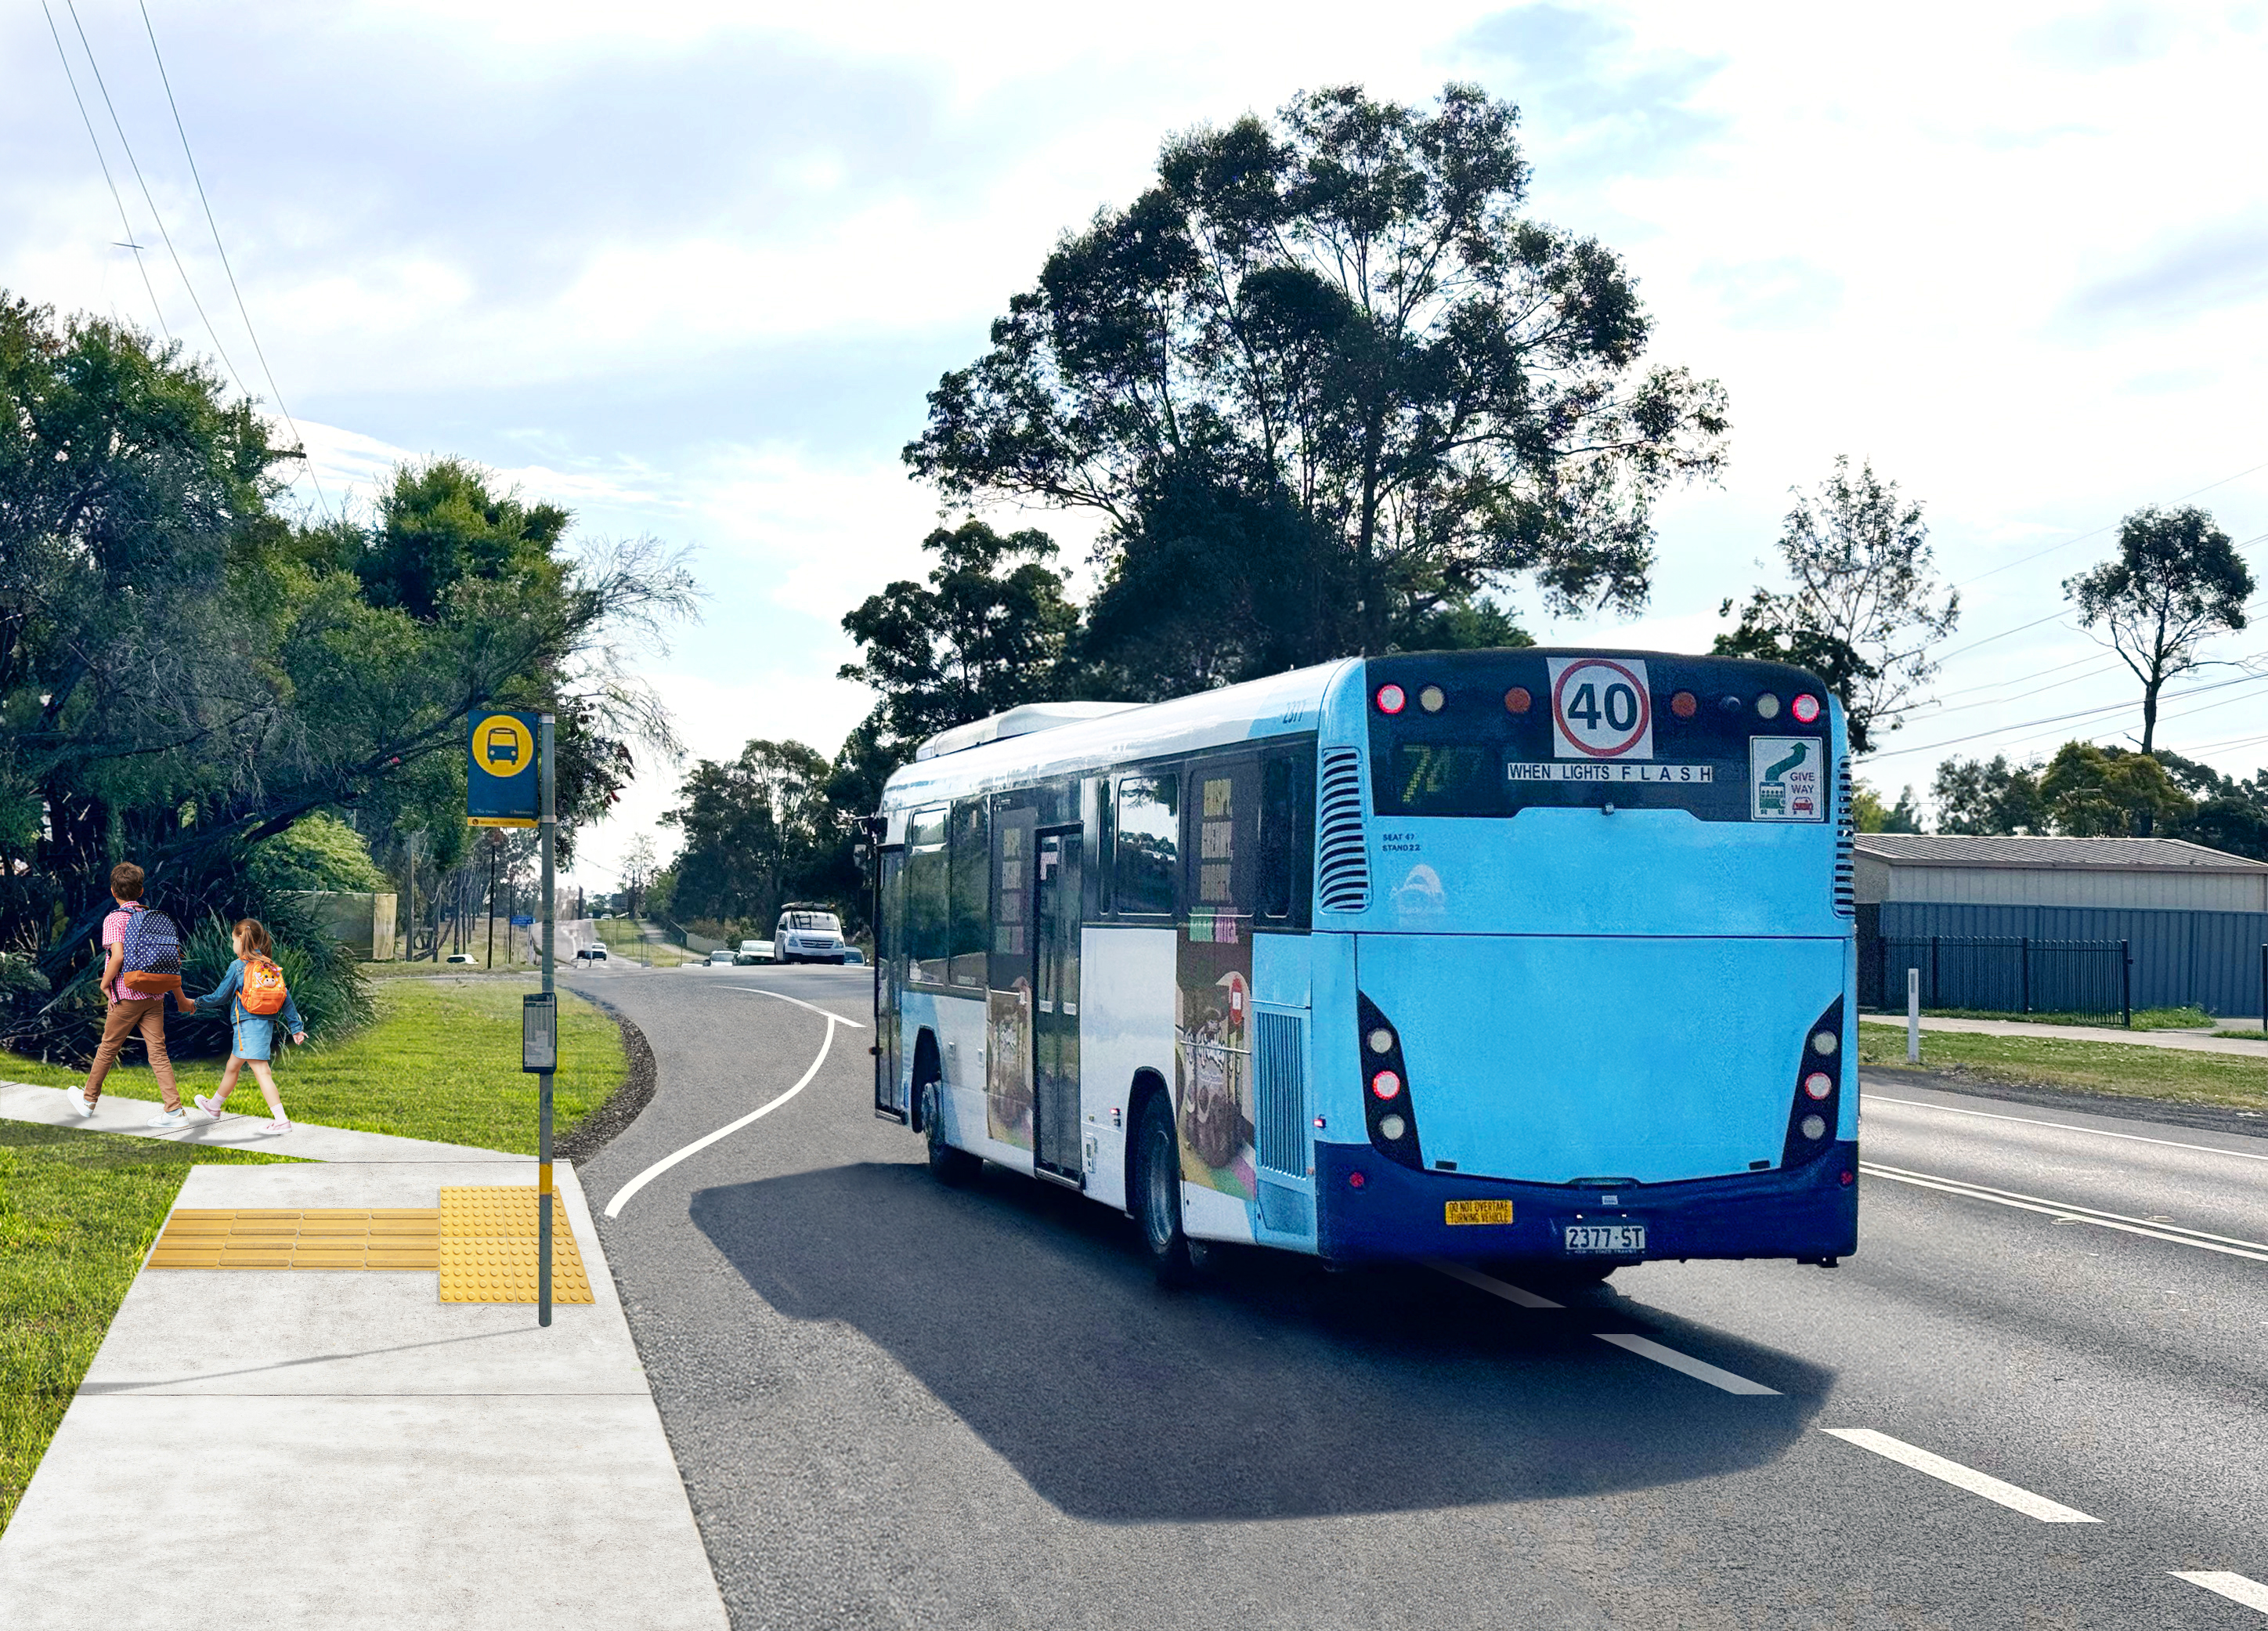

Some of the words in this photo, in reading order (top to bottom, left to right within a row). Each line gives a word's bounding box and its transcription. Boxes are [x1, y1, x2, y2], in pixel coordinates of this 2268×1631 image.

[1568, 682, 1638, 731] 40
[1509, 764, 1551, 779] WHEN
[1562, 765, 1609, 779] LIGHTS
[1790, 772, 1815, 782] GIVE
[1791, 784, 1814, 794] WAY
[1448, 1202, 1458, 1213] DO
[1460, 1202, 1472, 1212] NOT
[1475, 1201, 1508, 1212] OVERTAKE
[1450, 1213, 1479, 1223] TURNING
[1482, 1213, 1508, 1222] VEHICLE
